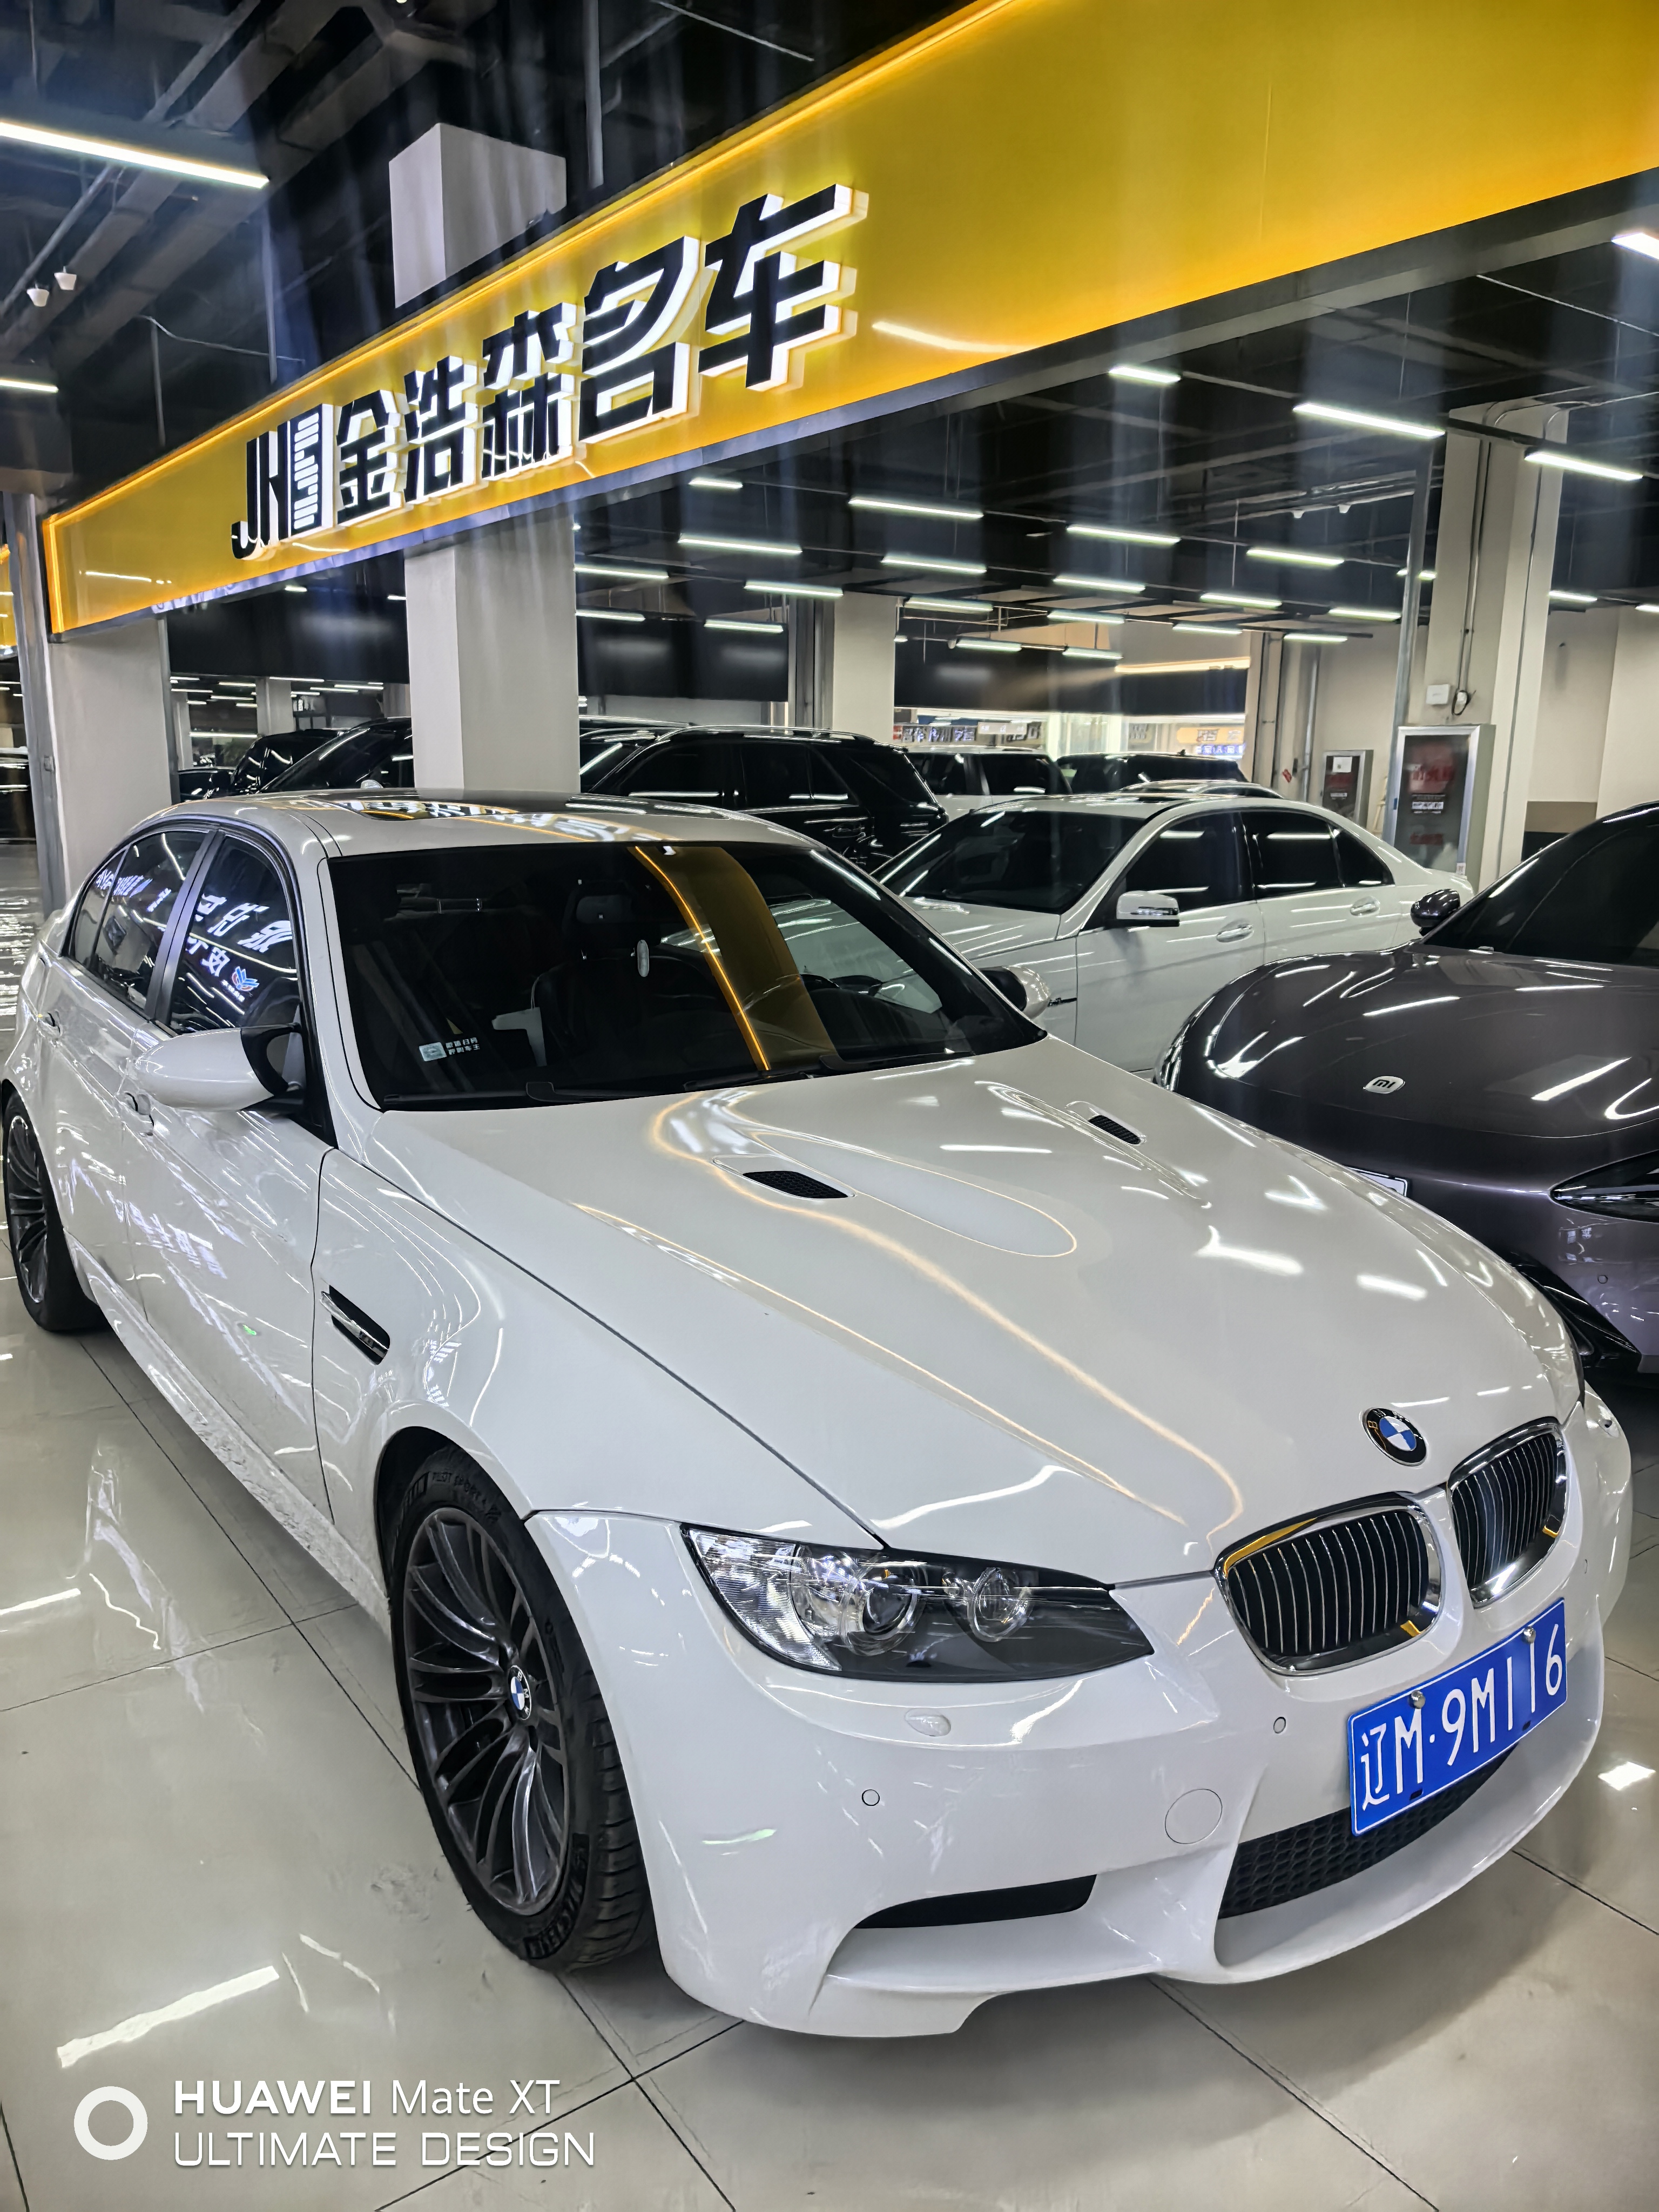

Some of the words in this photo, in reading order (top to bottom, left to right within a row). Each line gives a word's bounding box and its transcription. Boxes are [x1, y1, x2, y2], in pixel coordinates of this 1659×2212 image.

[336, 183, 852, 525] 金浩森名车
